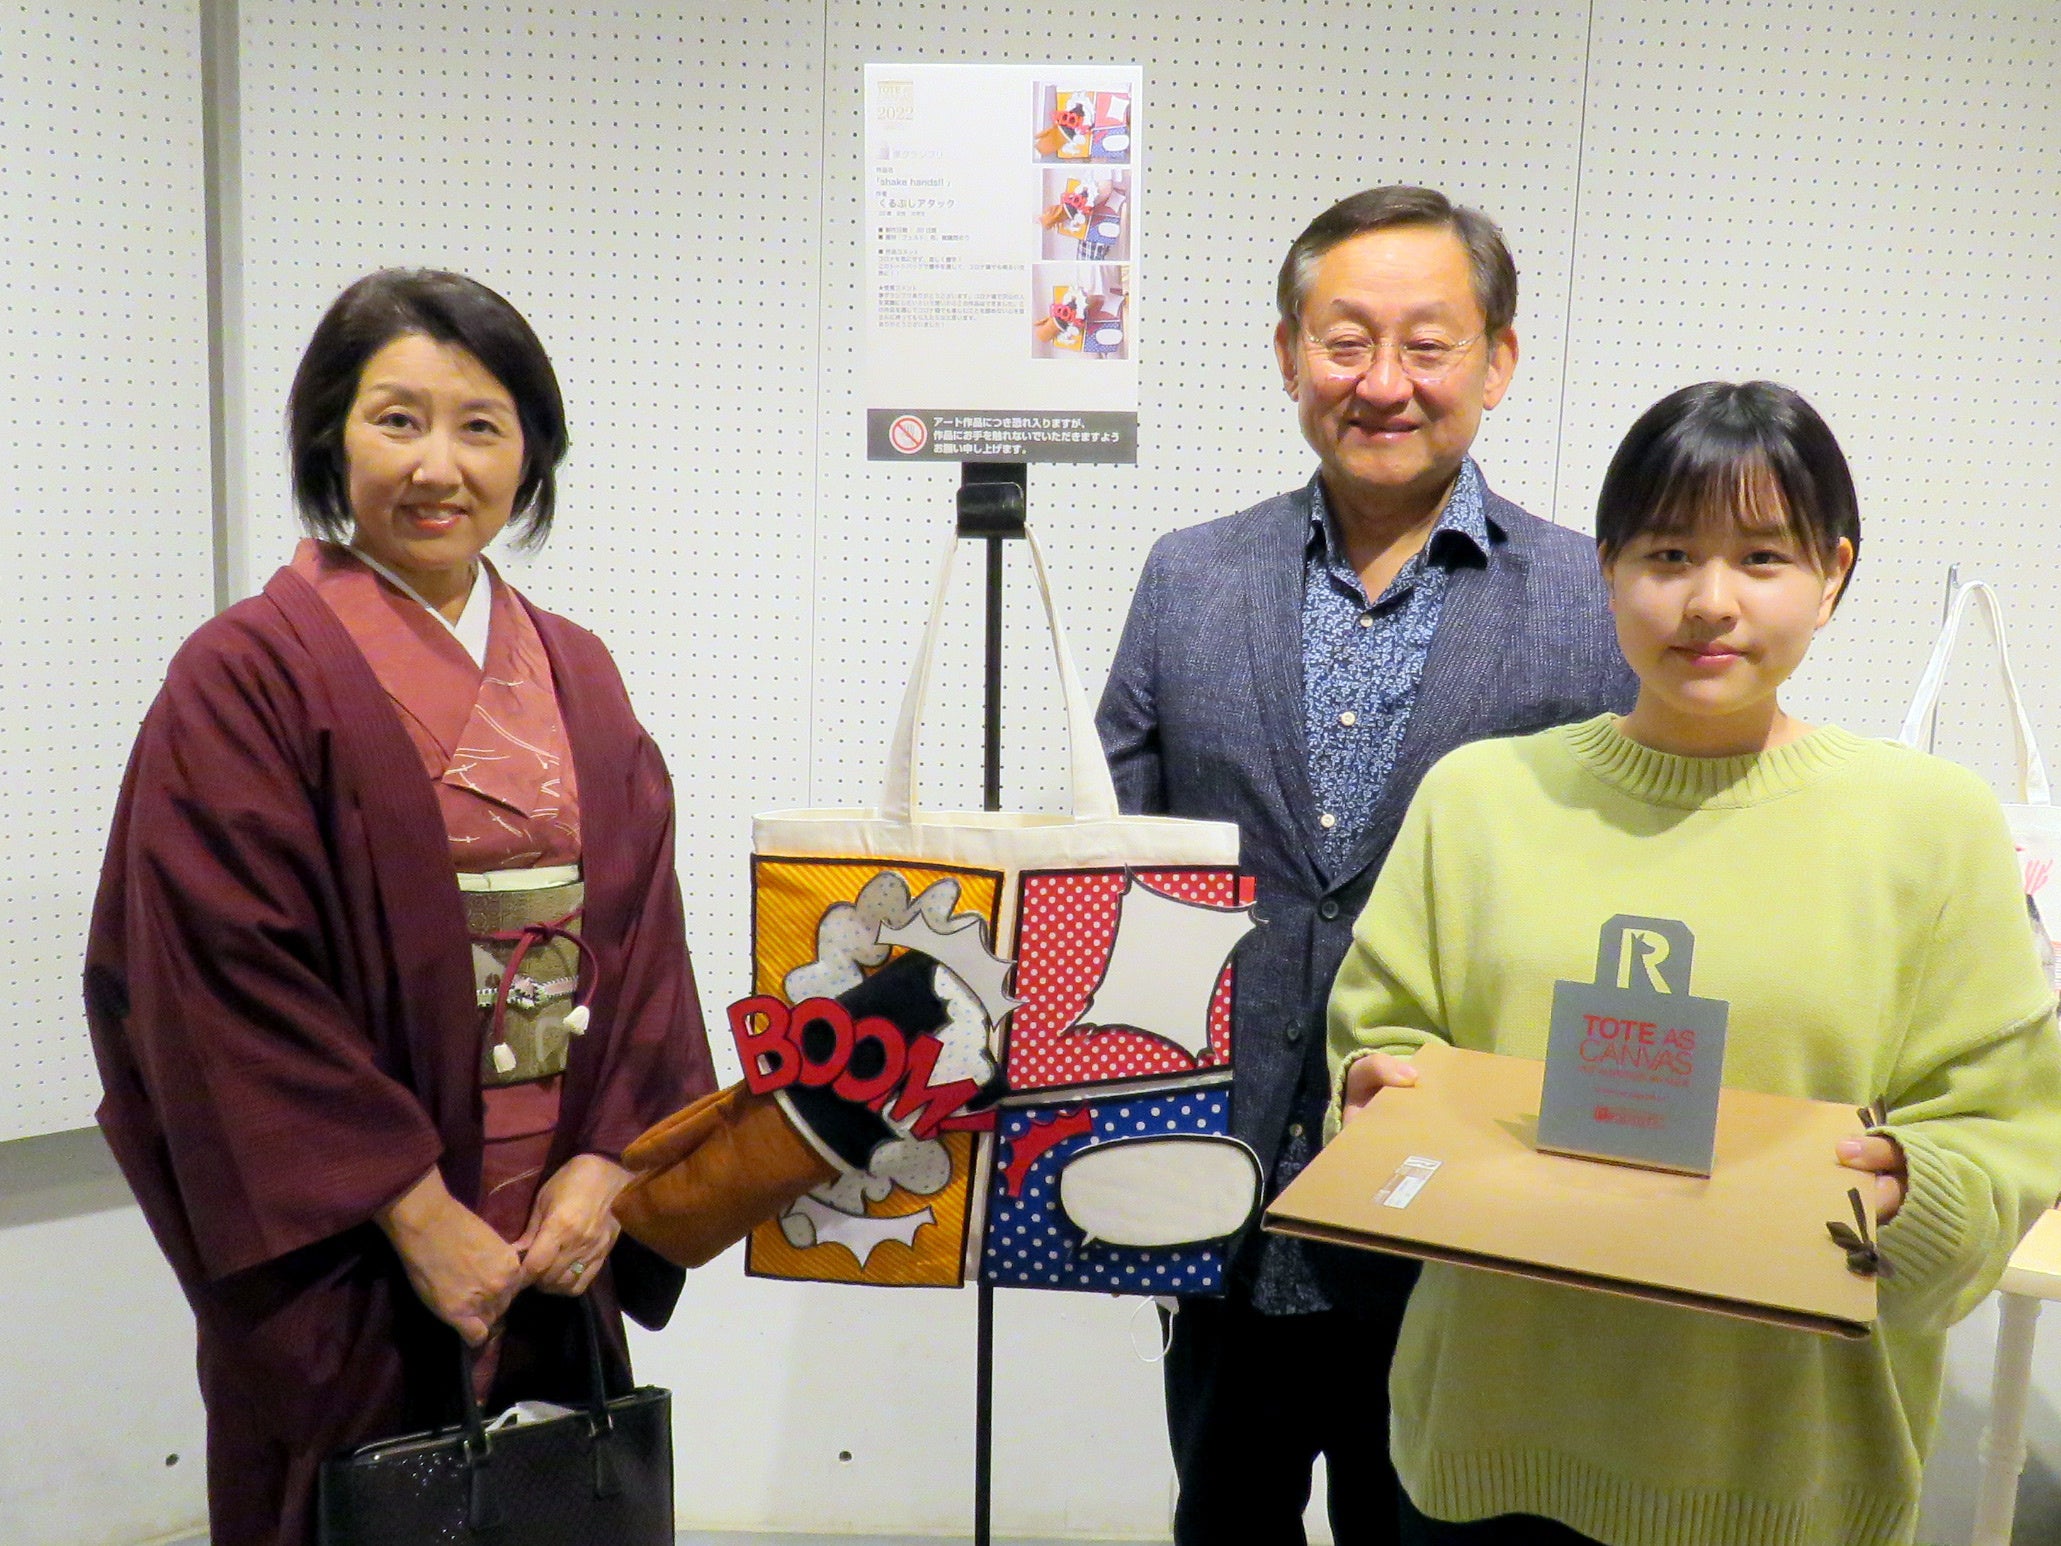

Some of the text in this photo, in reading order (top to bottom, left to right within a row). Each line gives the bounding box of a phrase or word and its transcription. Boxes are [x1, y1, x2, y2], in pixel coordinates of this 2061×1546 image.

[877, 106, 914, 120] 2022
[1583, 1014, 1697, 1051] TOTE AS
[1579, 1039, 1695, 1076] CANVAS
